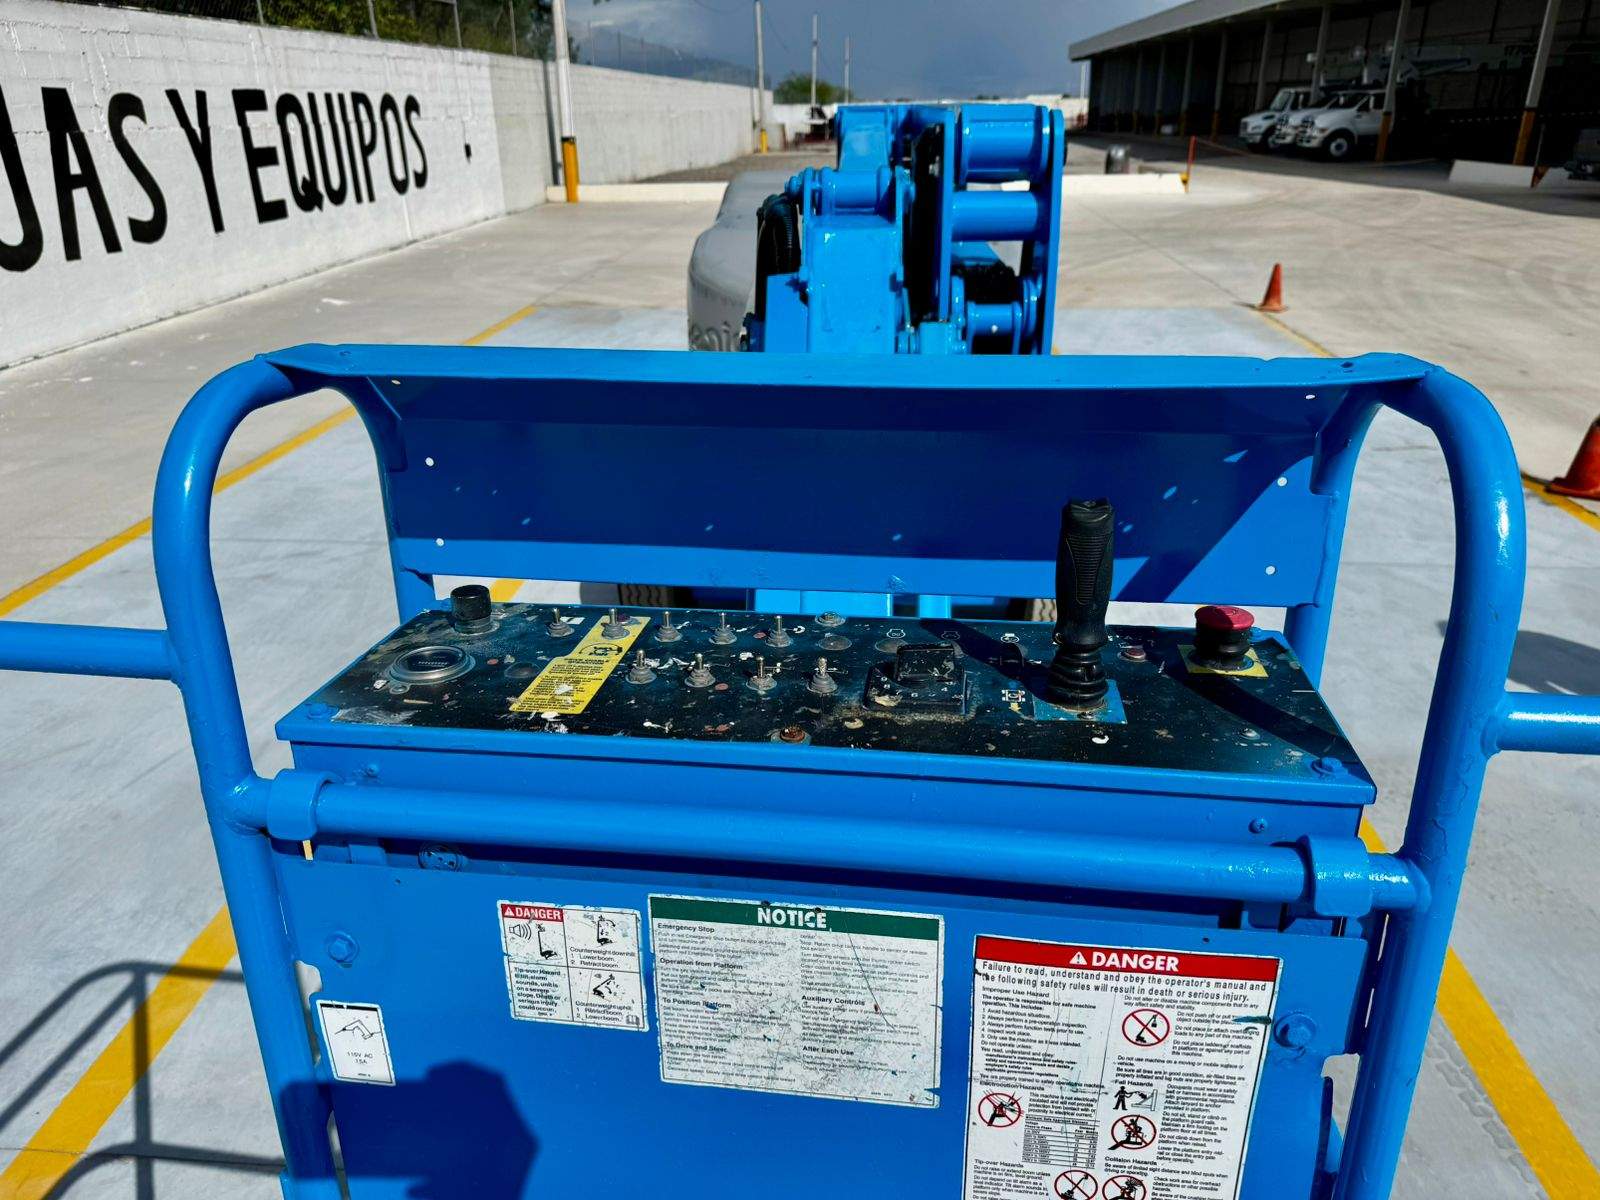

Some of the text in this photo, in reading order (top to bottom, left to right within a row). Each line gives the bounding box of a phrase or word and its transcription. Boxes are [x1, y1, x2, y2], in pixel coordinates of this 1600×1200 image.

[166, 89, 225, 233] Y
[232, 88, 428, 224] EQUIPOS
[515, 907, 562, 920] DANGER
[757, 907, 827, 928] NOTICE
[658, 923, 714, 934] Emergency Stop
[660, 958, 693, 966] Operation
[714, 961, 743, 969] Platform
[1091, 951, 1180, 972] DANGER
[983, 962, 1266, 991] Failure to read, understand and obey the operator's manual and
[982, 973, 995, 982] the
[998, 974, 1037, 987] following
[1040, 980, 1066, 990] safety
[1070, 982, 1090, 990] rules
[1094, 983, 1108, 992] will
[1111, 986, 1134, 994] result
[1138, 986, 1145, 995] in
[1149, 987, 1173, 997] death
[1188, 991, 1220, 1000] serious
[1223, 992, 1248, 1003] injury.
[982, 986, 1010, 994] Improper
[703, 1000, 731, 1008] Platform
[801, 994, 865, 1005] Auxiliary Controls
[987, 1021, 1004, 1029] Always
[987, 1027, 1004, 1035] Inspect
[676, 1042, 693, 1050] Drive
[1000, 1160, 1024, 1168] Hazards
